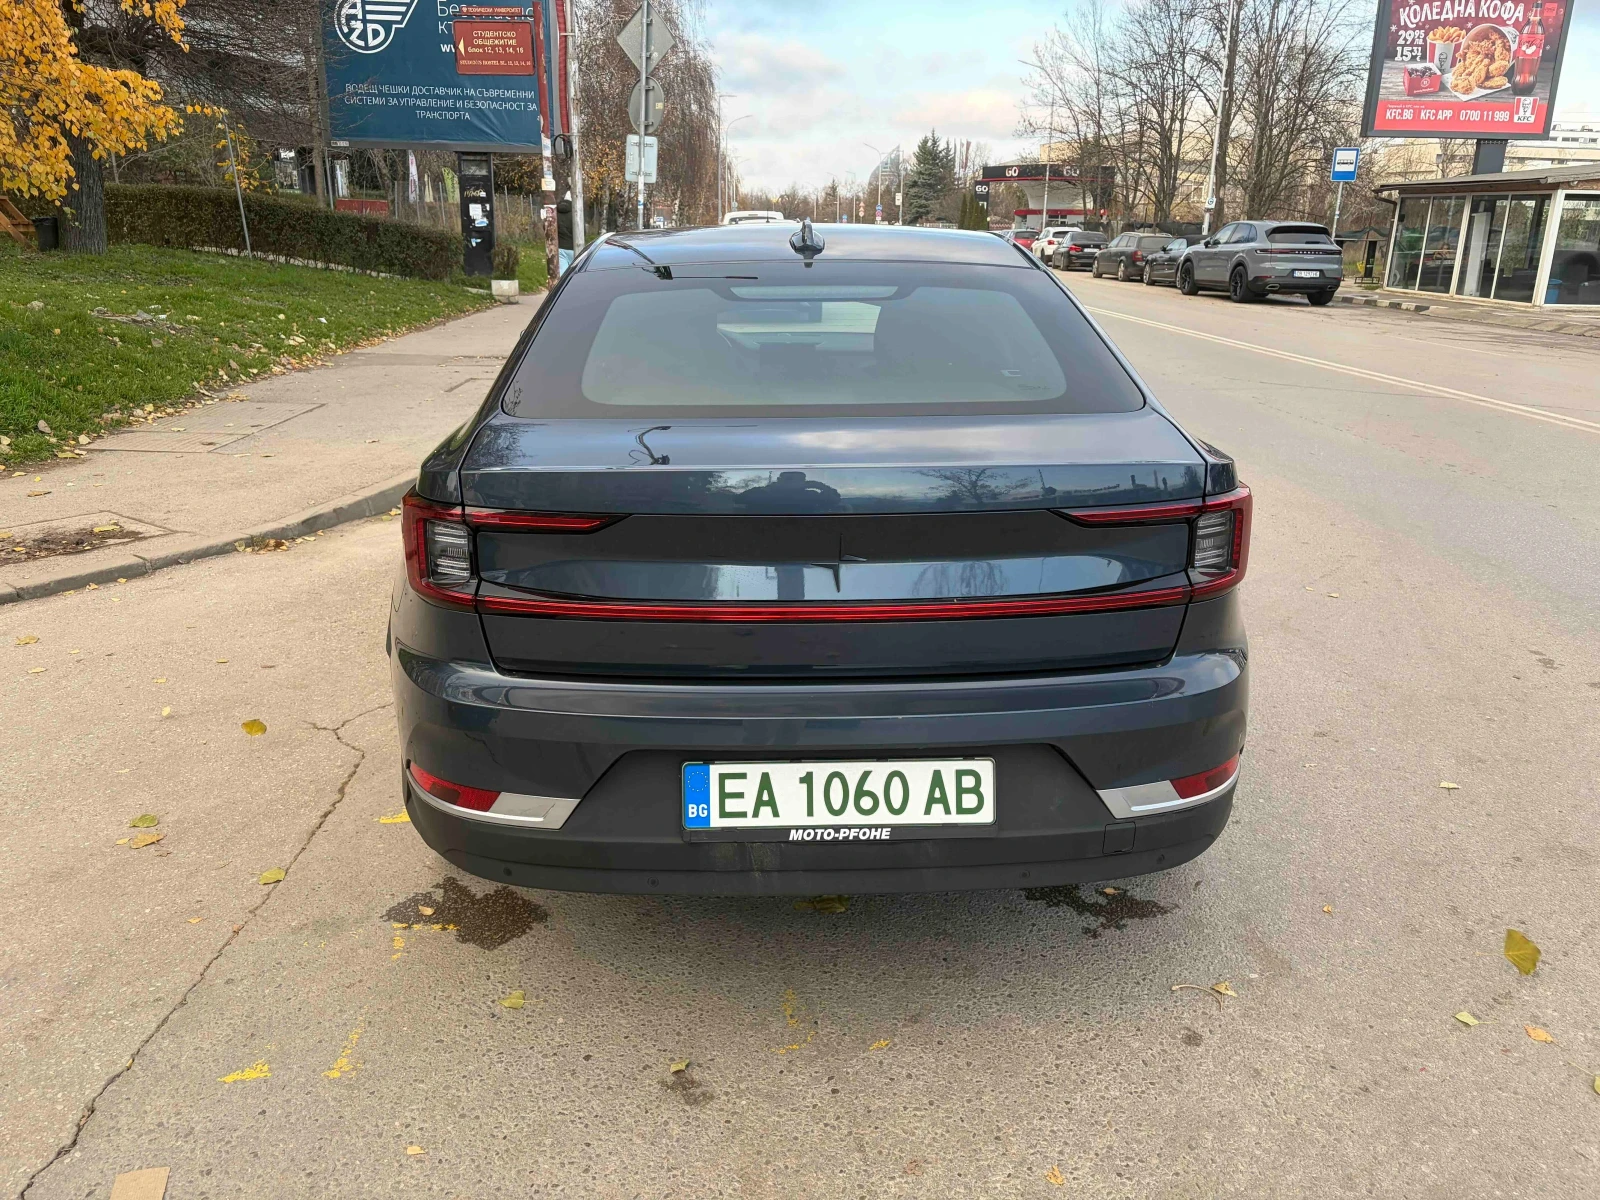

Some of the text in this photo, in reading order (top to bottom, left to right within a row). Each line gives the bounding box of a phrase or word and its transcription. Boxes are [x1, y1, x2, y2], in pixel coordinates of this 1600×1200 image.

[1400, 0, 1525, 28] КОЛЕДНА КОФА
[472, 30, 516, 38] СТУДЕНТСКО
[473, 38, 517, 46] ОБЩЕЖИТИЕ
[345, 83, 535, 99] ВОДЕЩ ЧЕШКИ ДОСТАВЧИК НА СЪВРЕМЕННИ
[344, 95, 538, 111] СИСТЕМИ ЗА УПРАВЛЕНИЕ И БЕЗОПАСНОСТ ЗА
[415, 110, 471, 120] ТРАНСПОРТА
[1385, 108, 1510, 122] KFC.BG KFC APP 0700 11 999
[1005, 166, 1019, 177] GO
[718, 768, 985, 819] EA 1060 AB
[687, 803, 708, 818] BG
[788, 828, 892, 841] MOTO-PFOHE
